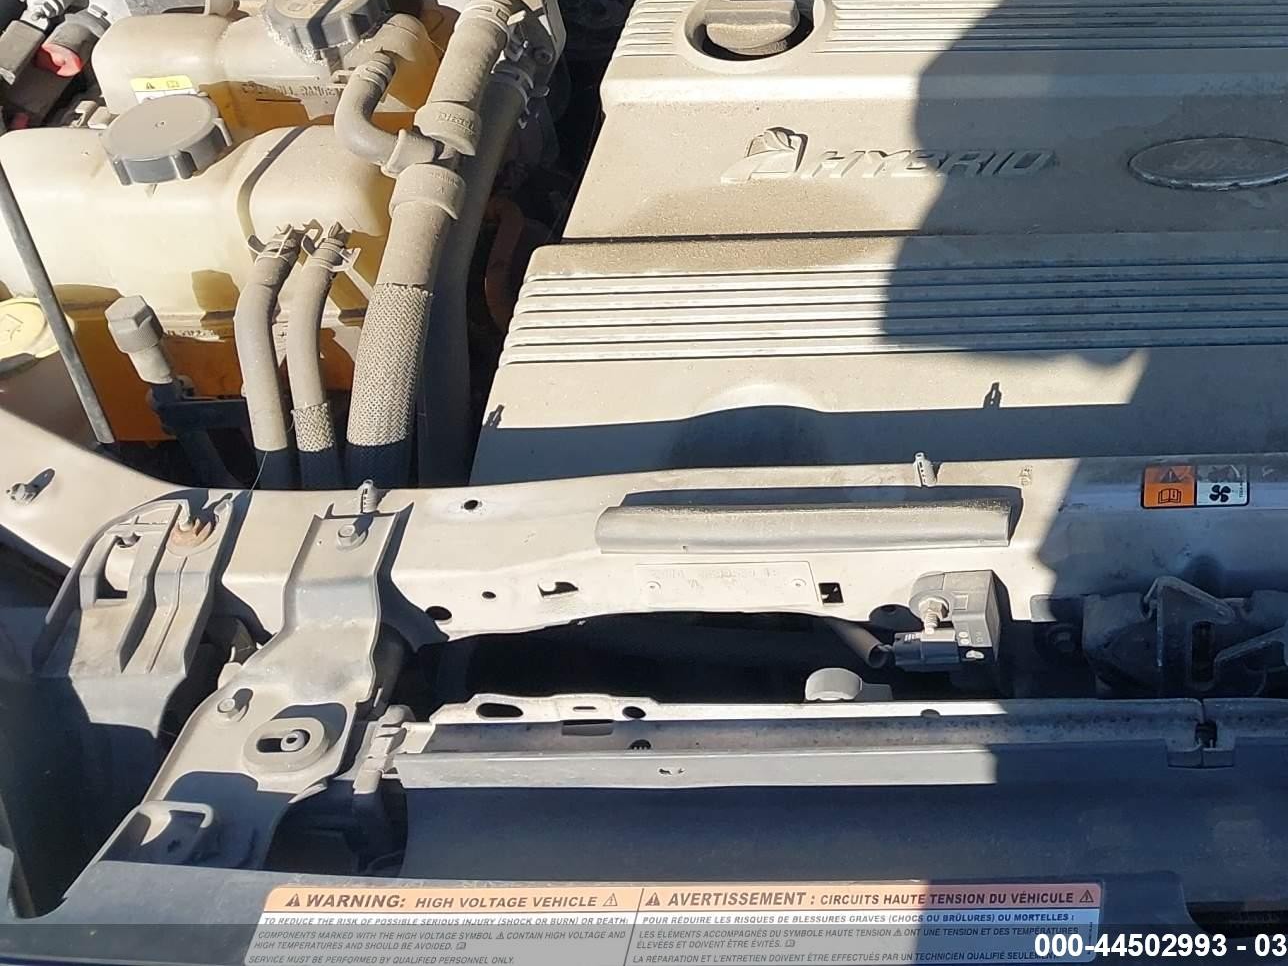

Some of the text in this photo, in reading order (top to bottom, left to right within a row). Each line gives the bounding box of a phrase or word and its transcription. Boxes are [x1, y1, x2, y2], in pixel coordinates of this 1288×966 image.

[801, 149, 1057, 178] HYBRID
[306, 894, 598, 908] WARNING: HIGH VOLTAGE VEHICLE
[667, 892, 807, 906] AVERTISSEMENT
[821, 894, 879, 905] CIRCUITS
[883, 894, 926, 905] HAUTE
[929, 894, 986, 904] TENSION
[989, 893, 1007, 904] DU
[1011, 890, 1073, 904] VÉHICULE
[264, 917, 629, 926] TO REDUCE THE RISK OF POSSIBLE SERIOUS INJURY (SHOCK OR BURN) OR DEATH:
[670, 915, 712, 924] RÉDUIRE
[714, 916, 731, 924] LES
[734, 916, 775, 924] RISQUES
[791, 915, 846, 923] BLESSURES
[849, 915, 886, 923] GRAVES
[888, 915, 924, 923] (CHOCS
[926, 915, 940, 923] OU
[942, 912, 996, 922] BRÛLURES)
[997, 914, 1013, 922] OU
[1013, 914, 1069, 922] MORTELLES
[258, 931, 626, 939] COMPONENTS MARKED WITH THE HIGH VOLTAGE SYMBOL CONTAIN HIGH VOLTAGE AND
[657, 929, 701, 938] ÉLÉMENTS
[703, 928, 768, 938] ACCOMPAGNÉS
[783, 929, 823, 937] SYMBOLE
[825, 929, 853, 937] HAUTE
[904, 928, 921, 936] ONT
[923, 928, 941, 936] UNE
[942, 928, 979, 936] TENSION
[980, 927, 993, 935] ET
[993, 927, 1011, 935] DES
[254, 941, 452, 950] HIGH TEMPERATURES AND SHOULD BE AVOIDED.
[248, 956, 514, 964] SERVICE MUST BE PERFORMED BY QUALIFIED PERSONNEL ONLY.
